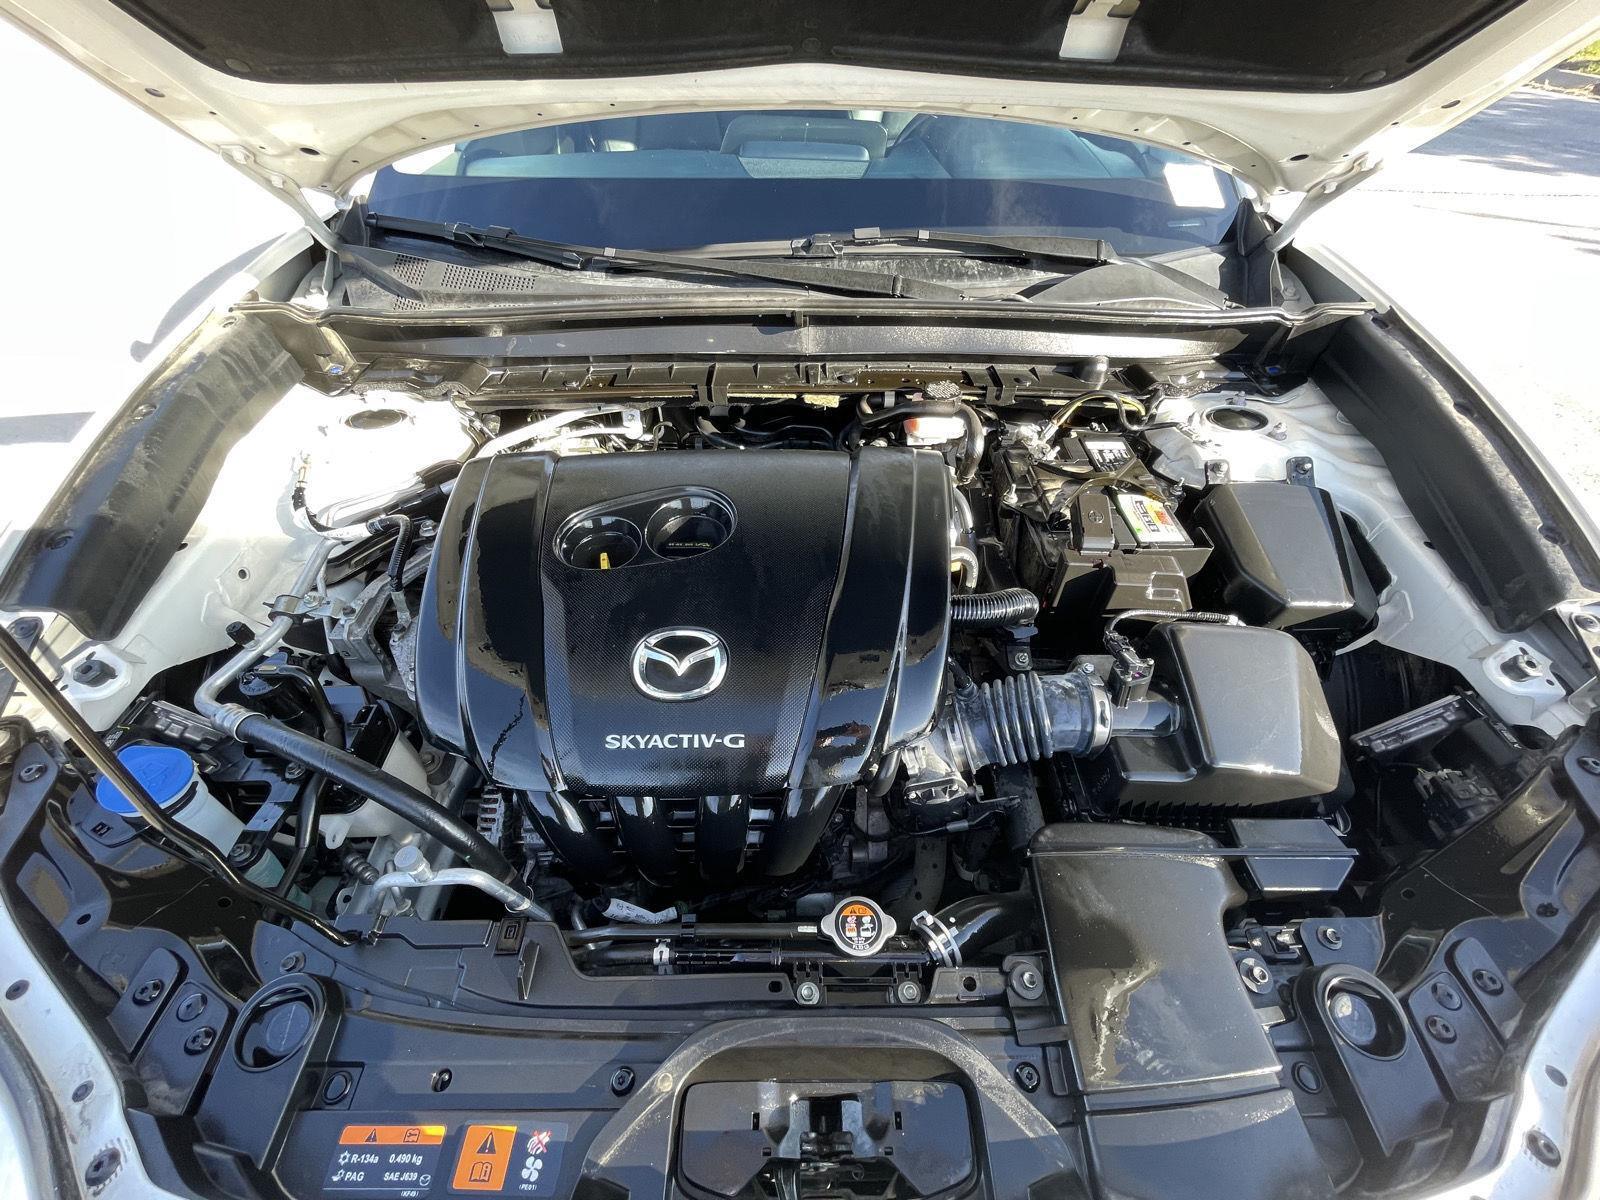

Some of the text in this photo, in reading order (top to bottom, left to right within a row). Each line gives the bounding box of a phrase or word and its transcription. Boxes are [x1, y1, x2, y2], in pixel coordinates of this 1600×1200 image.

[604, 733, 745, 749] SKYACTIV-G
[351, 1153, 423, 1165] R-134a 0.490 kg
[344, 1172, 417, 1182] PAG SAE J639
